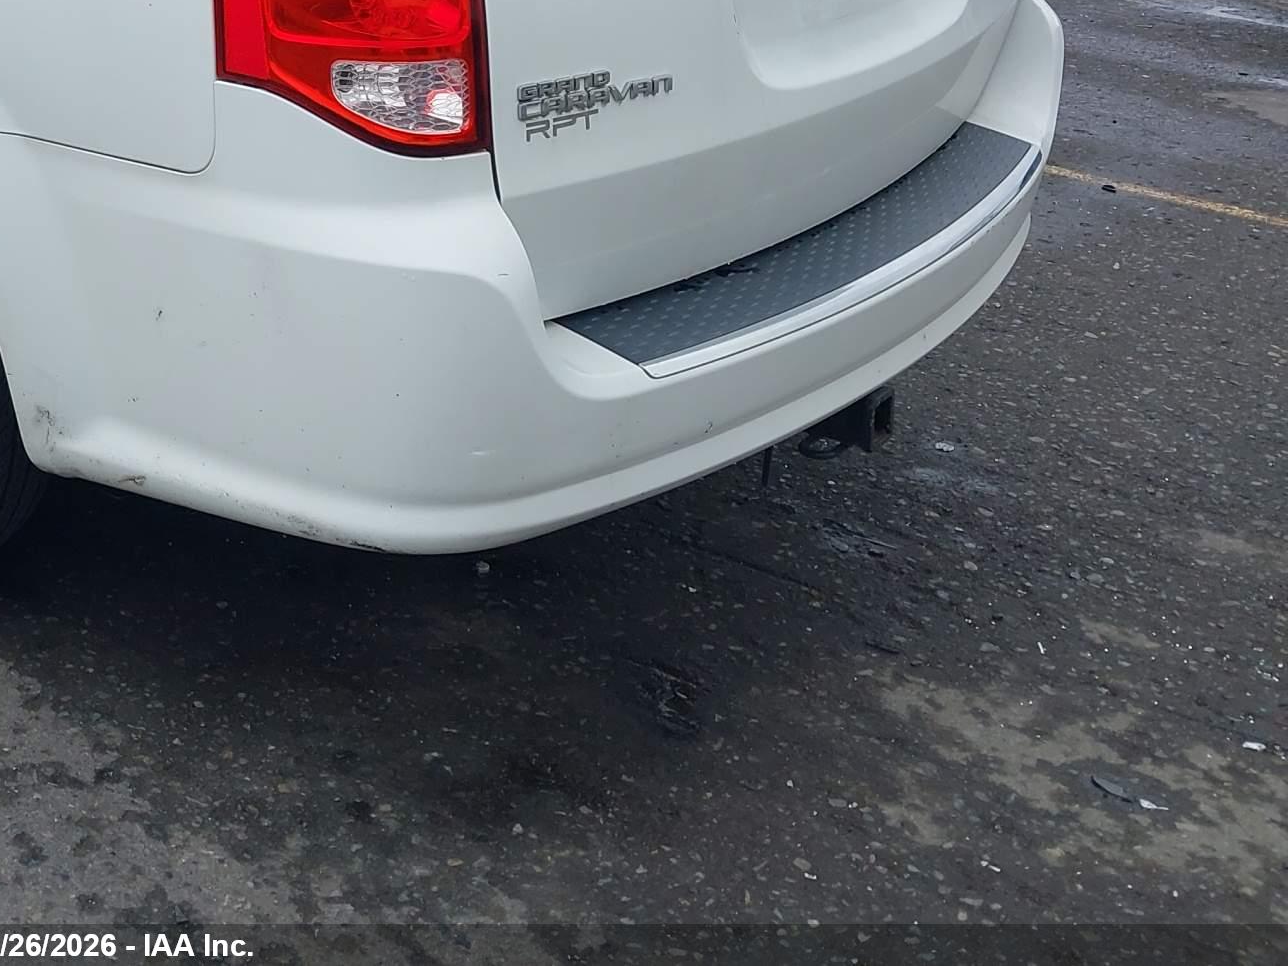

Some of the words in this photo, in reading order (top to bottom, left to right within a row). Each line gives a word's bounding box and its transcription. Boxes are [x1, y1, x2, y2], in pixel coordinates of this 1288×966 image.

[517, 69, 611, 102] GRAND
[517, 75, 673, 121] CARAVAN
[525, 108, 599, 143] RPT
